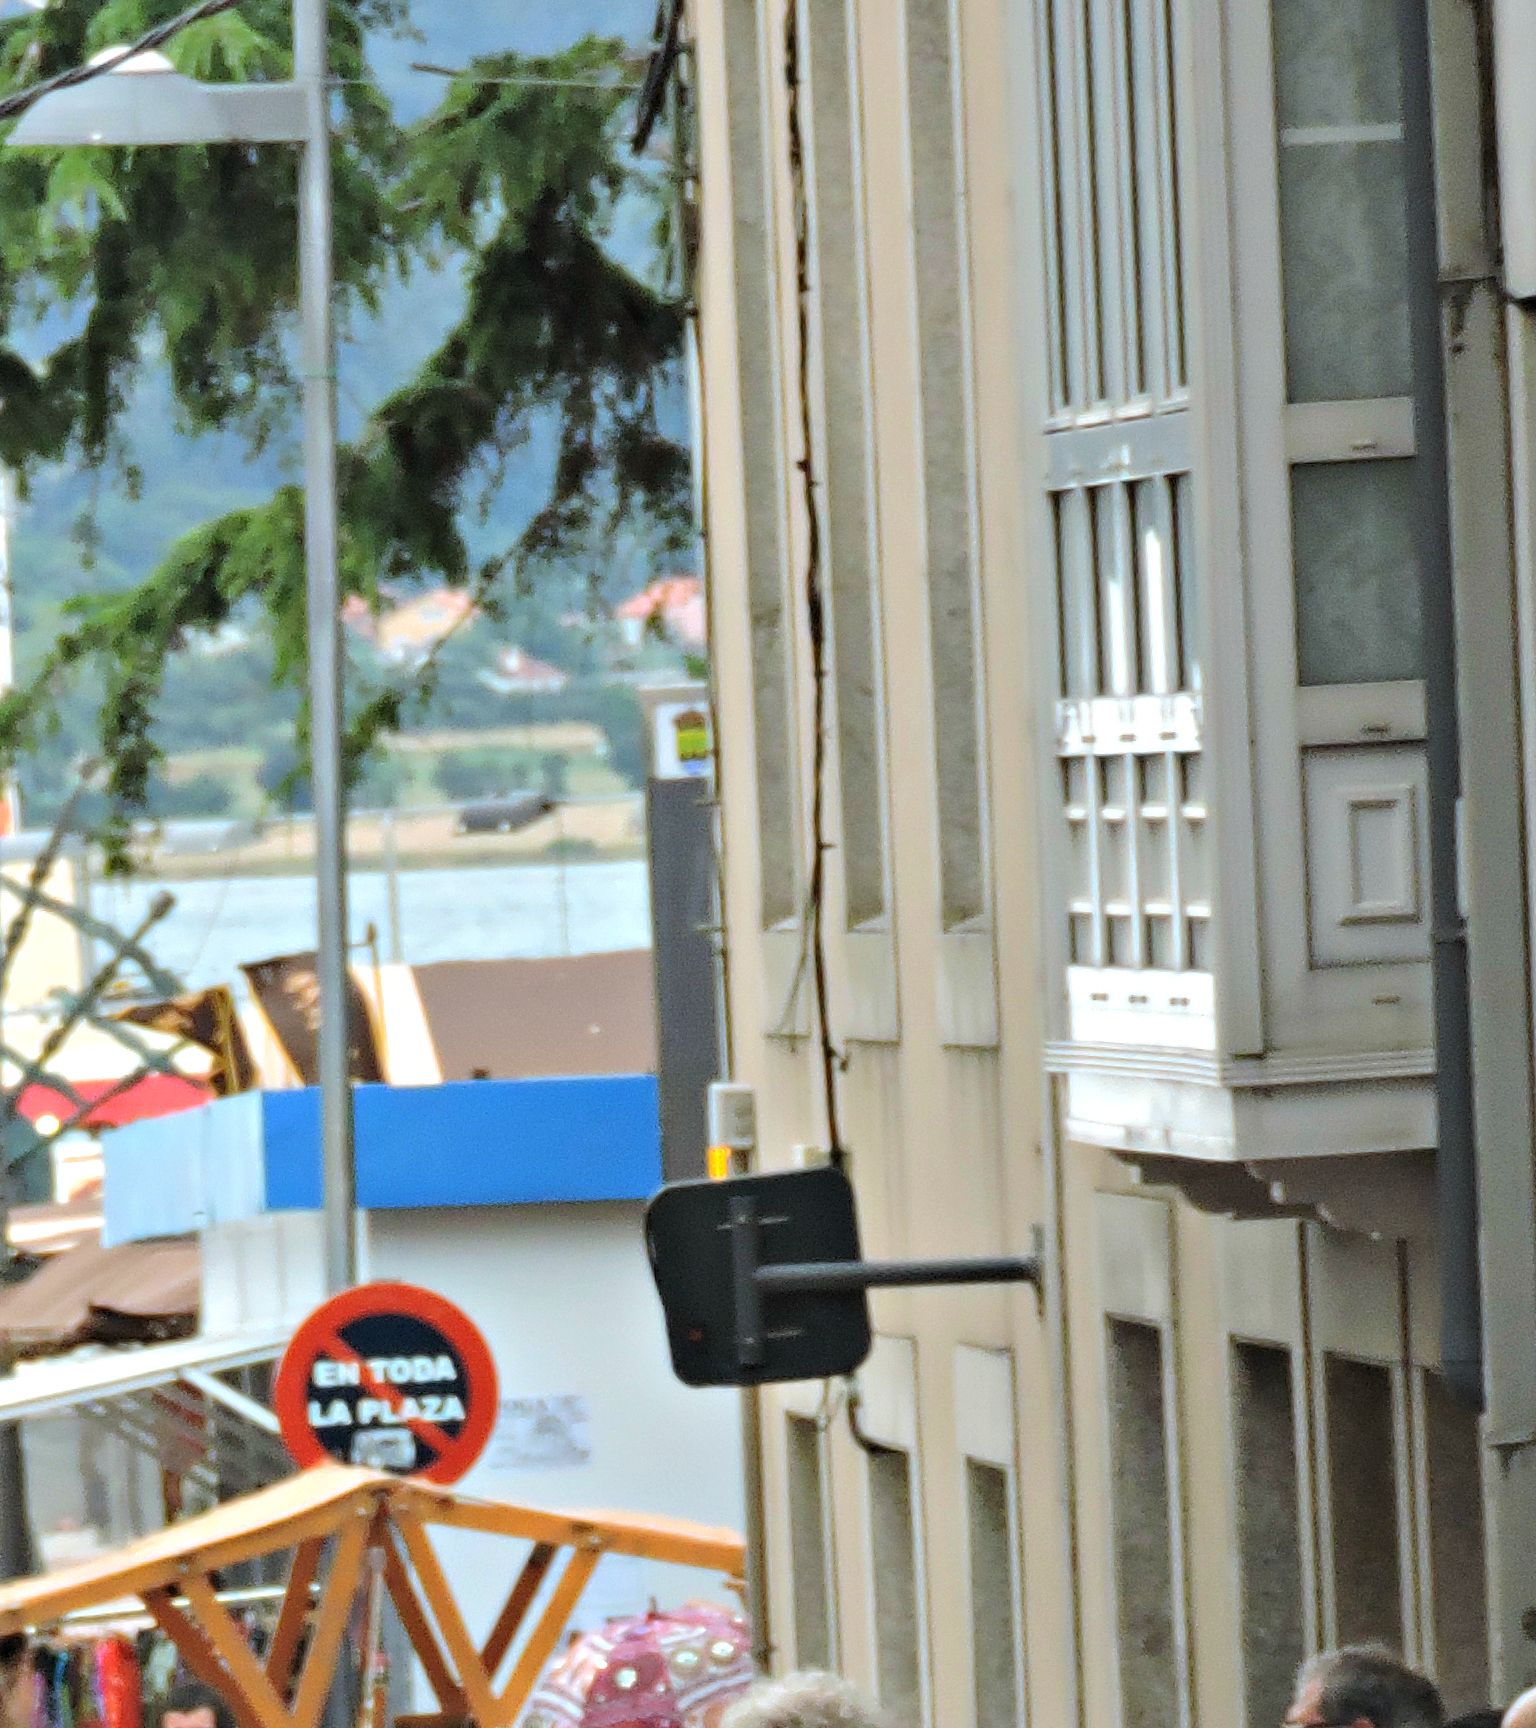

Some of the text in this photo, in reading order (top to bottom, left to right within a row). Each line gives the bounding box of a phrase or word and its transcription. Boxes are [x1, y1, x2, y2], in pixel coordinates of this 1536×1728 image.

[312, 1354, 458, 1388] EN TODA
[307, 1393, 466, 1428] LA PLAZA
